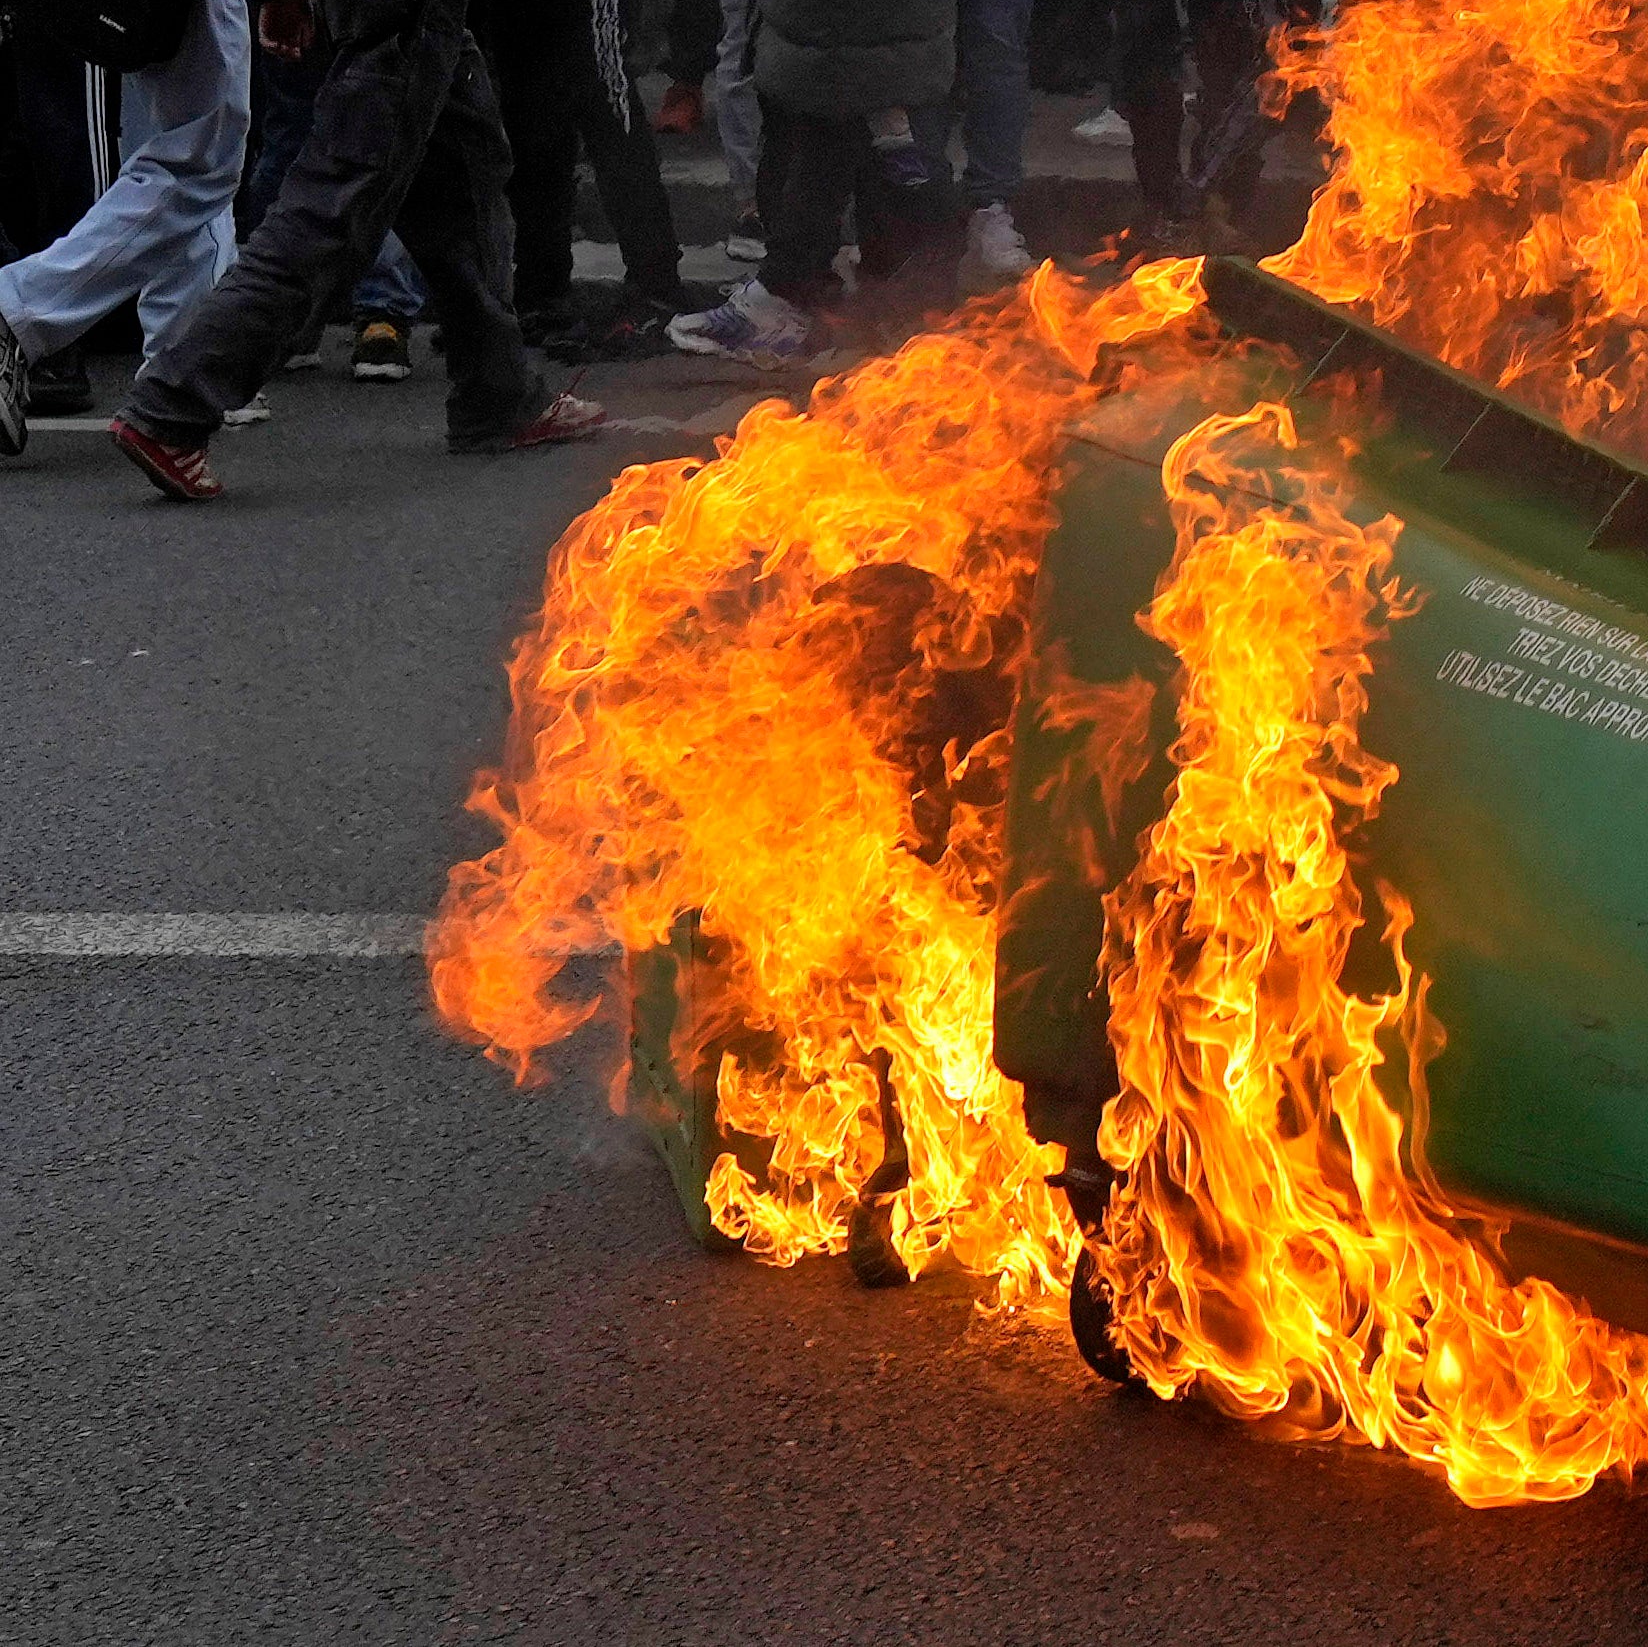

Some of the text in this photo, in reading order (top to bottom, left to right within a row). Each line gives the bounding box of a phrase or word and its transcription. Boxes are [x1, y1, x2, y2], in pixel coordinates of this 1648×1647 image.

[1460, 574, 1495, 602] NE
[1484, 583, 1569, 626] DÉPOSEZ
[1556, 610, 1606, 640] RIEN
[1597, 627, 1640, 654] SUR
[1436, 649, 1525, 699] UTILISEZ
[1513, 673, 1551, 706] LE
[1539, 682, 1591, 719] BAC
[1507, 627, 1567, 666] TRIEZ
[1557, 644, 1604, 679] VOS
